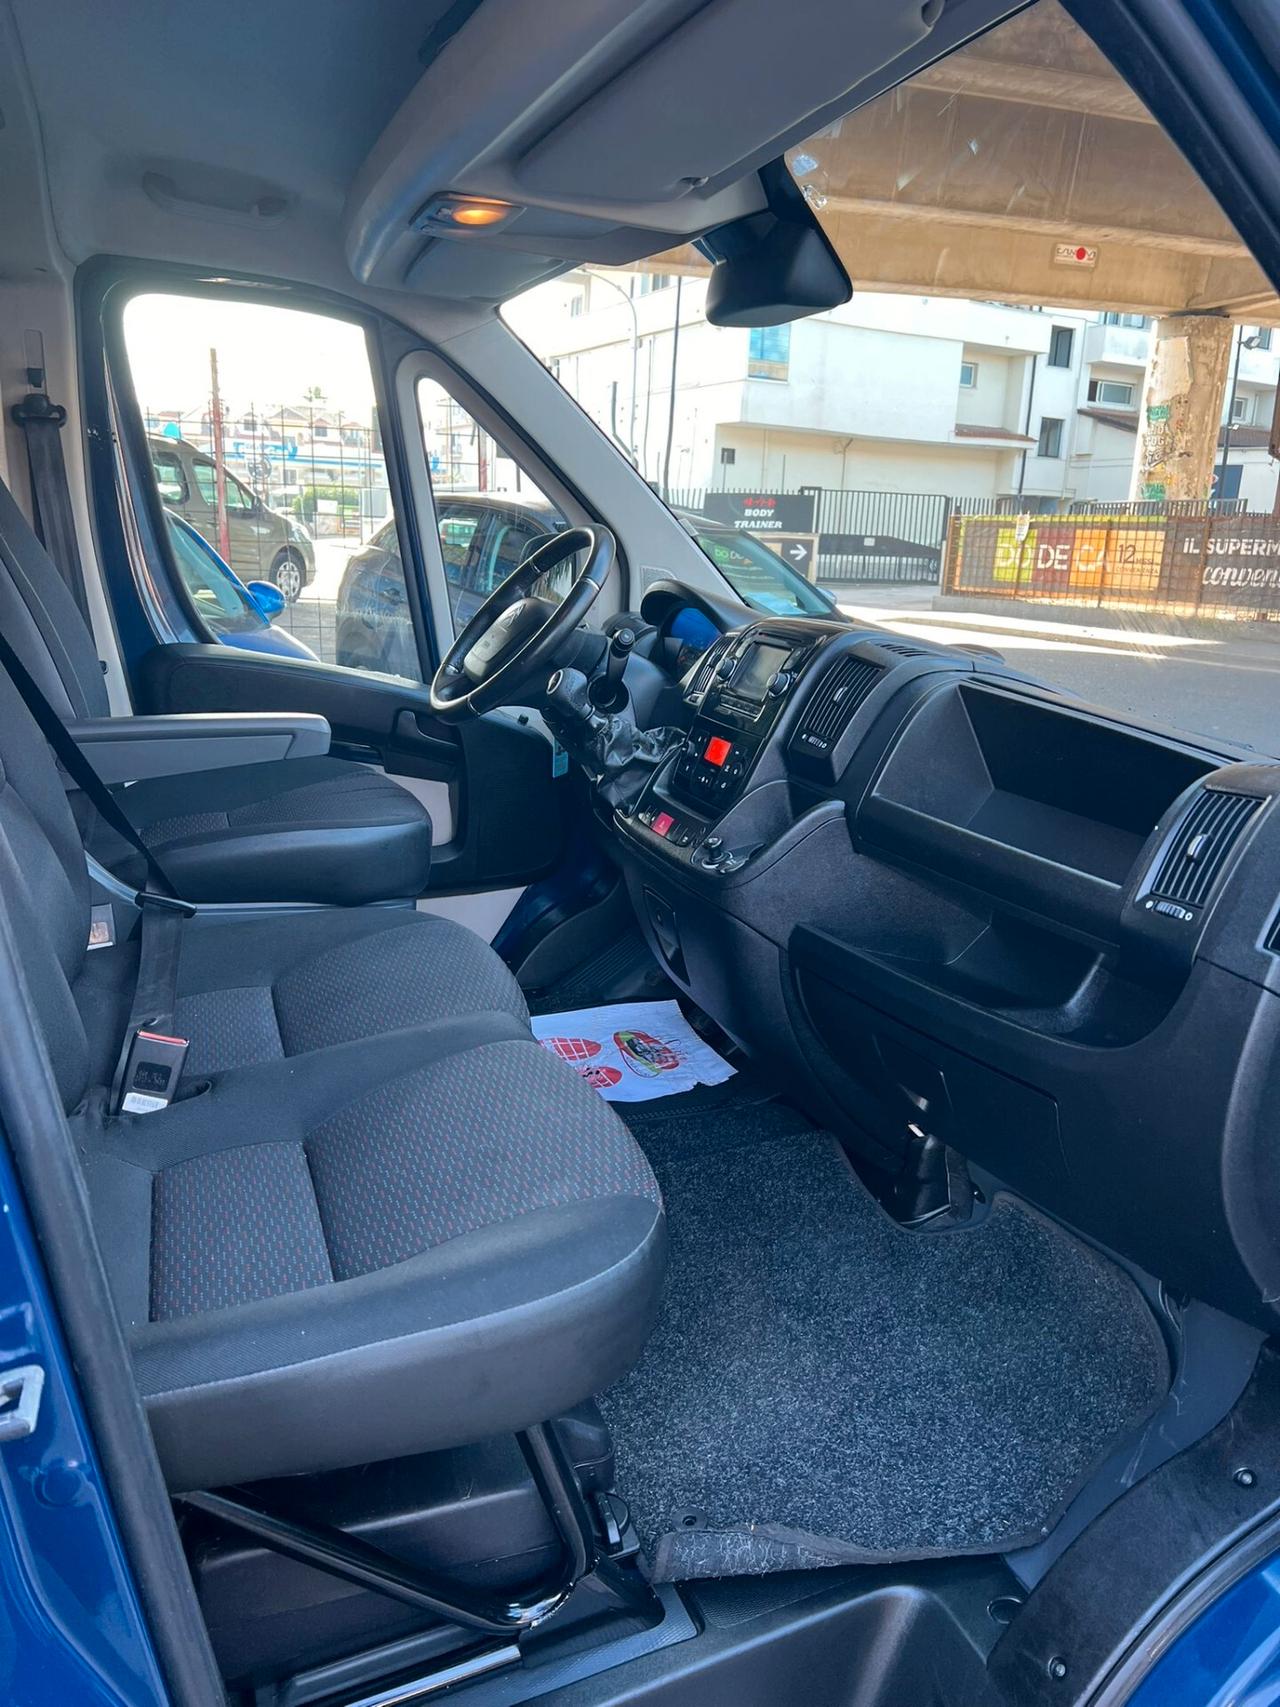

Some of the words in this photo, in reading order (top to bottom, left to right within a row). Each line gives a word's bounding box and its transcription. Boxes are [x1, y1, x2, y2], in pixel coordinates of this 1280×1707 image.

[744, 508, 774, 517] BODY
[734, 520, 783, 529] TRAINER
[1182, 537, 1200, 554] IL
[1037, 544, 1070, 570] DE
[1118, 544, 1136, 564] 12
[1202, 566, 1280, 588] conven
